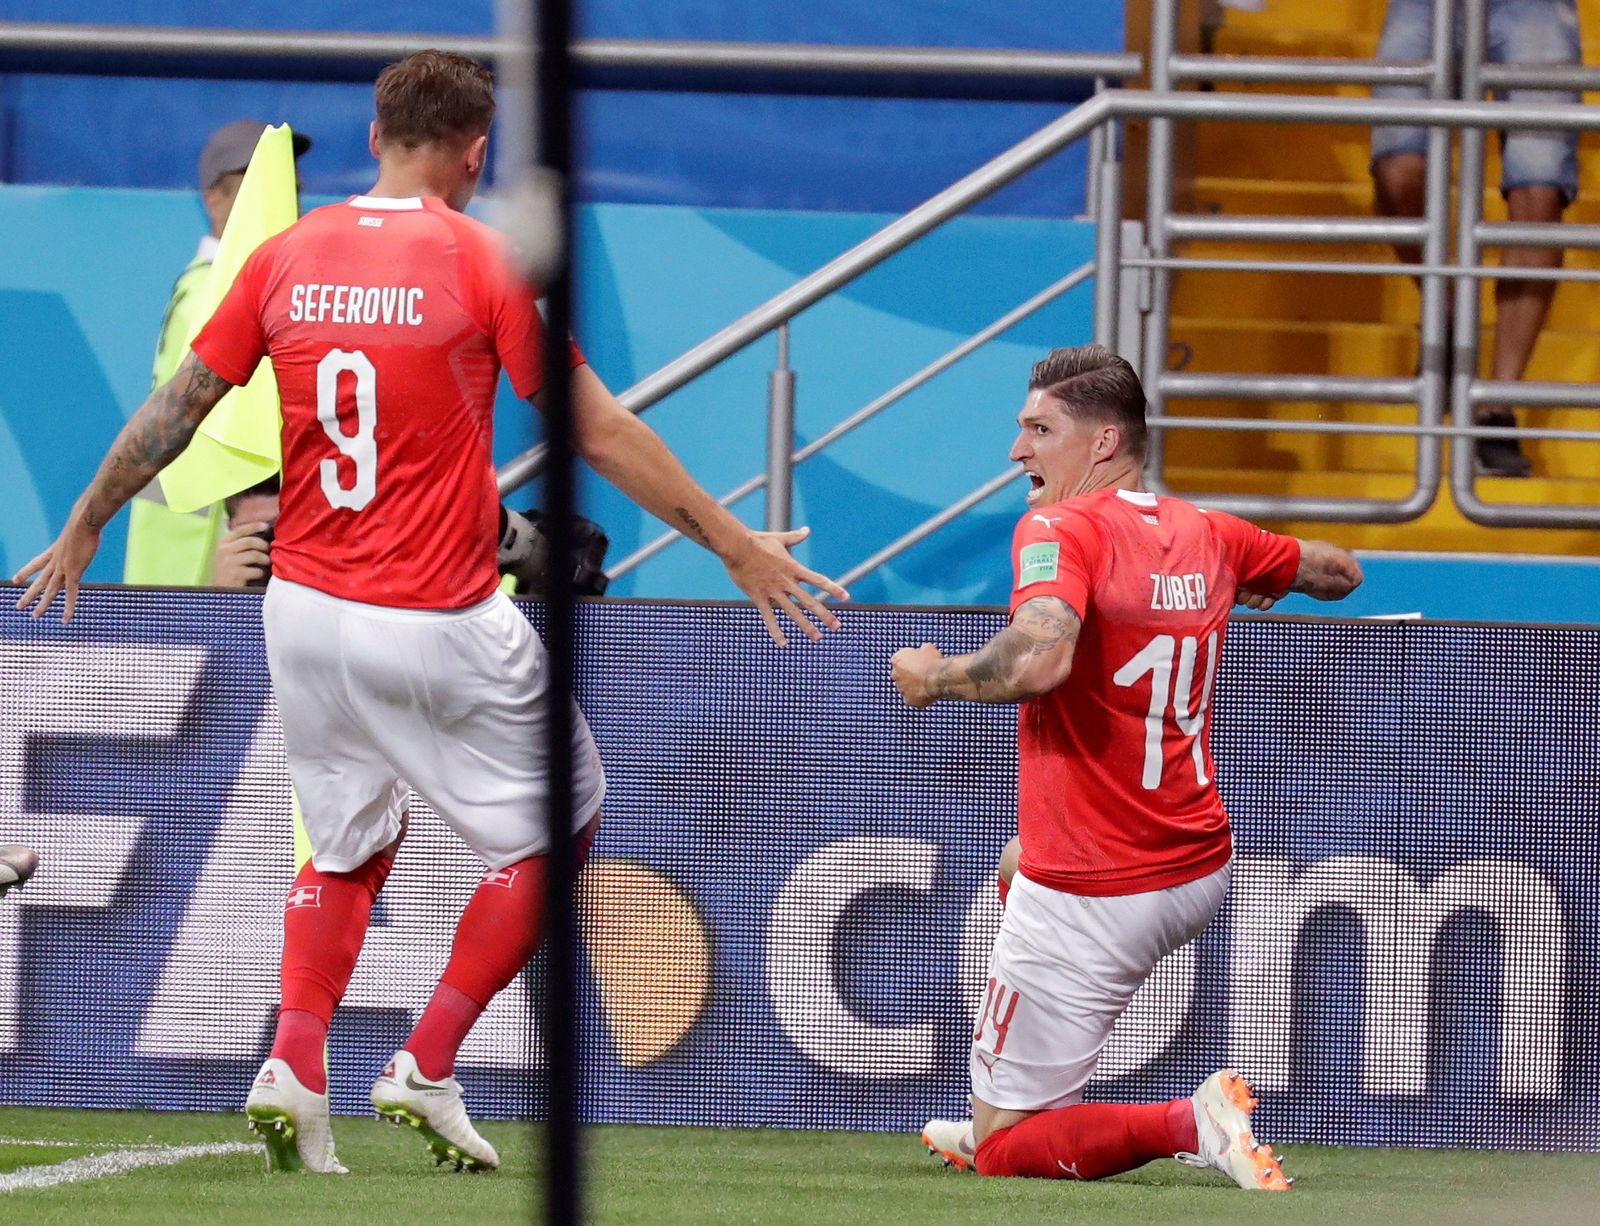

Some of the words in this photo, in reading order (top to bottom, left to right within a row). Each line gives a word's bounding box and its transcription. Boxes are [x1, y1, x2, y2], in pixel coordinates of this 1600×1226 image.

[289, 284, 424, 326] SEFEROVIC
[316, 347, 378, 513] 9
[1149, 572, 1208, 611] ZUBER
[1112, 629, 1219, 790] 14
